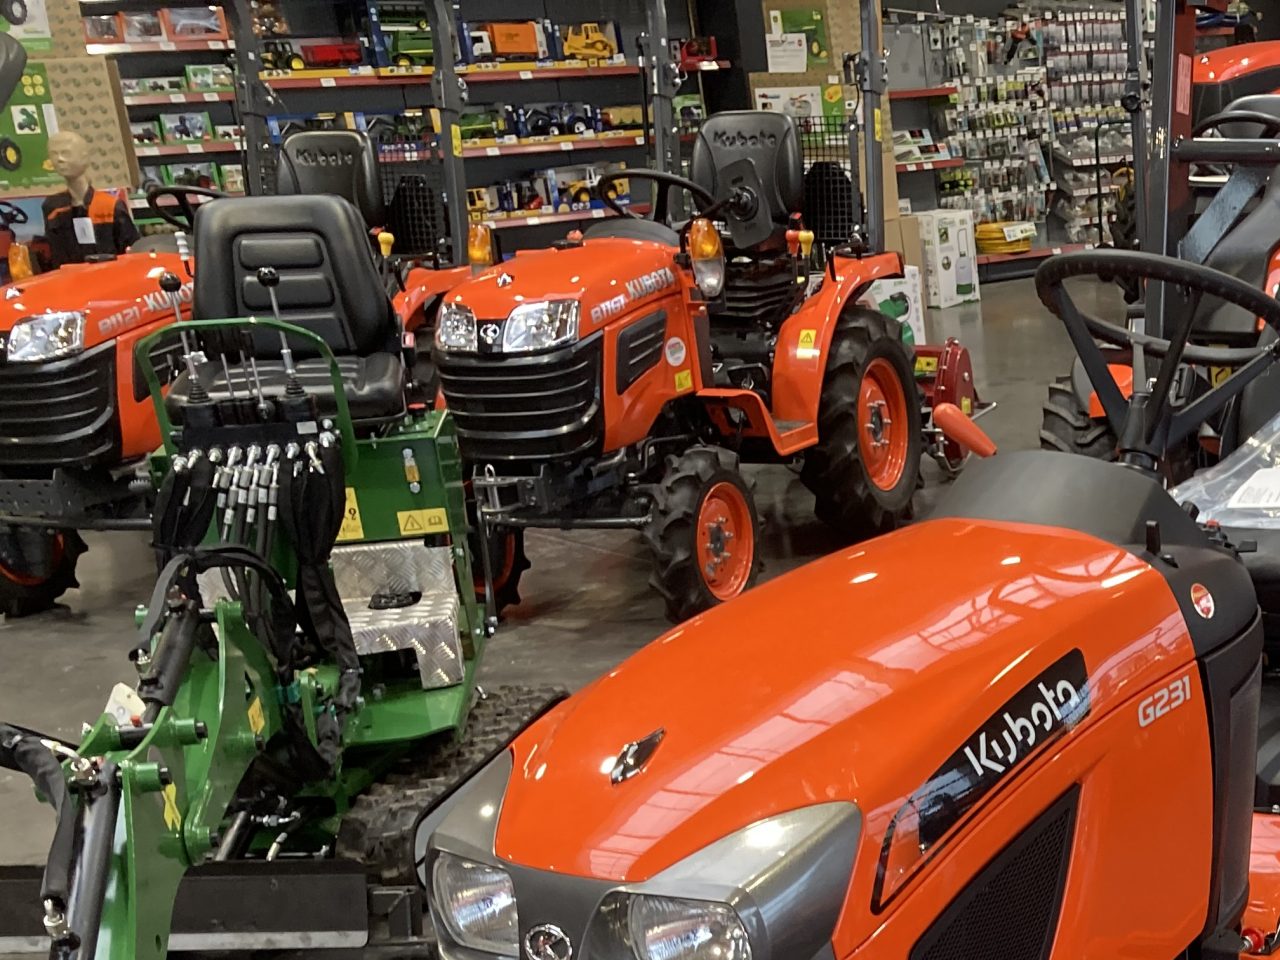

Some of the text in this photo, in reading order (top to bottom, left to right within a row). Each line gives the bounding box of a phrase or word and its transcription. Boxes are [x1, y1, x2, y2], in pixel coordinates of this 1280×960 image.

[714, 131, 776, 146] Kubota
[625, 267, 674, 300] KUBOTA
[1138, 675, 1191, 728] G231
[963, 679, 1081, 777] Kubota
